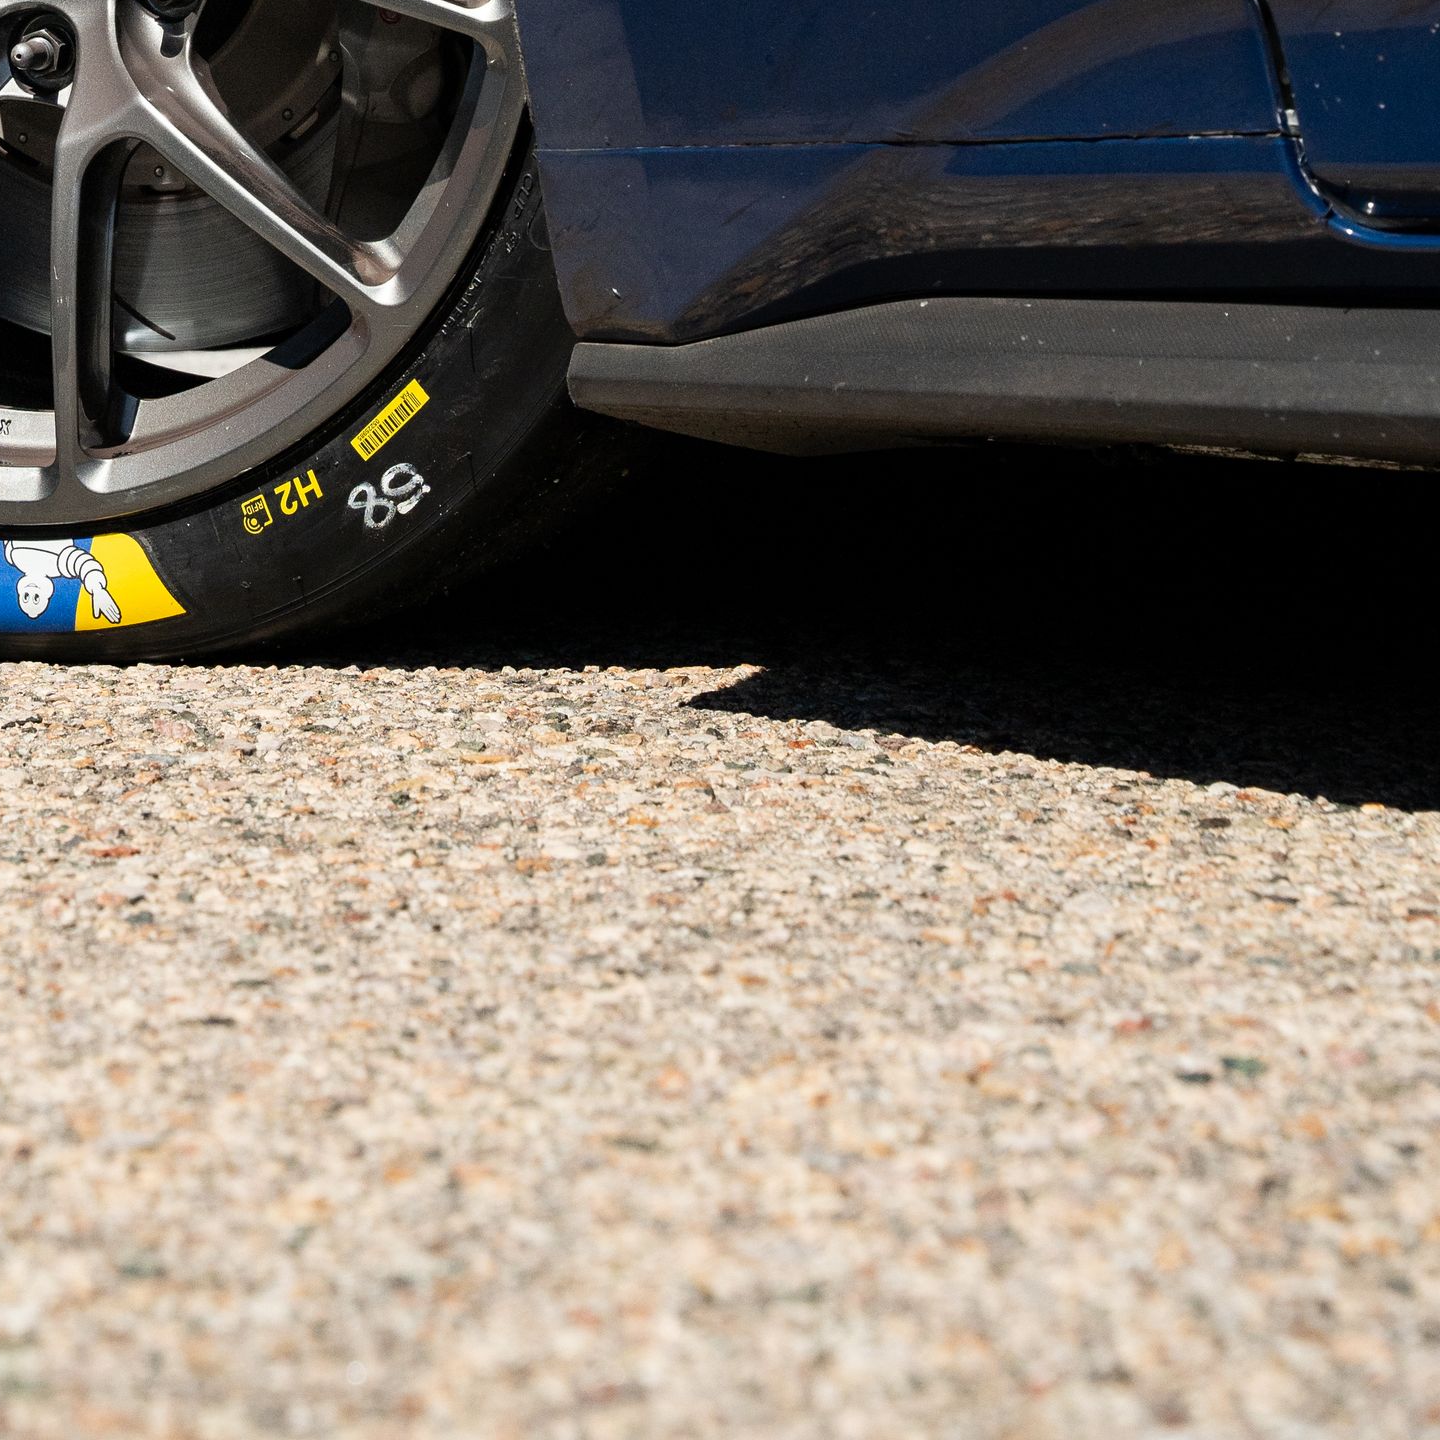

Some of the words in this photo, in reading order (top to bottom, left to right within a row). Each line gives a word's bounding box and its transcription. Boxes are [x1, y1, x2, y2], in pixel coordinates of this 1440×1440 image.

[243, 495, 266, 516] RFID
[273, 468, 324, 517] H2
[347, 461, 432, 531] 58
